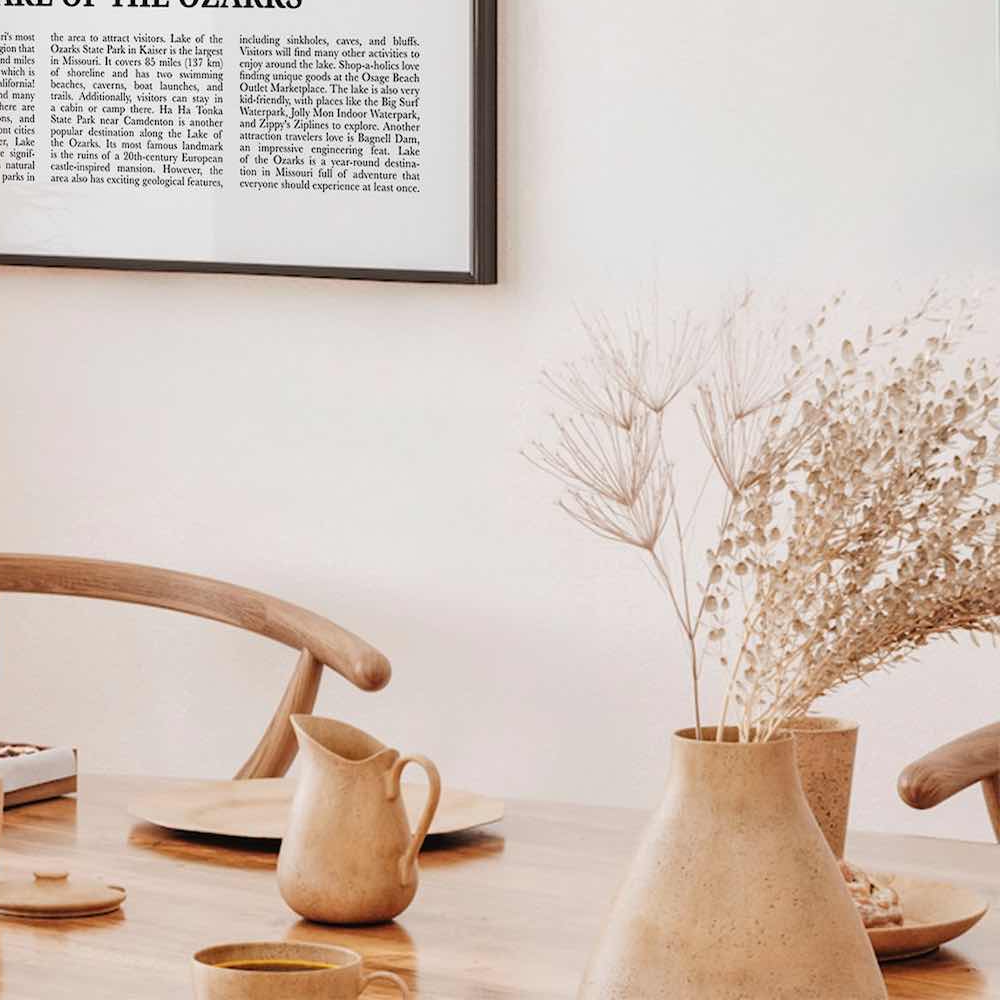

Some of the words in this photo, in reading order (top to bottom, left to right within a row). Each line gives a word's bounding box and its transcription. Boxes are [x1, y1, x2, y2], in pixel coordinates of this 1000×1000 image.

[14, 33, 34, 41] most
[50, 32, 63, 41] the
[89, 34, 98, 42] to
[102, 34, 129, 42] attract
[133, 34, 166, 42] visitors.
[170, 34, 190, 43] Lake
[194, 34, 205, 43] of
[209, 34, 223, 43] the
[239, 35, 280, 46] including
[286, 35, 329, 46] sinkholes,
[368, 36, 386, 45] and
[393, 36, 419, 46] bluffs.
[50, 44, 80, 53] Ozarks
[82, 44, 104, 54] State
[107, 45, 125, 54] Park
[128, 46, 136, 54] in
[139, 45, 166, 54] Kaiser
[169, 46, 176, 54] is
[178, 46, 192, 55] the
[194, 46, 223, 57] largest
[240, 47, 272, 56] Visitors
[275, 47, 291, 56] will
[294, 47, 311, 56] find
[314, 50, 339, 59] many
[341, 48, 365, 57] other
[368, 49, 407, 58] activities
[410, 50, 420, 58] to
[13, 55, 35, 64] miles
[239, 59, 263, 70] enjoy
[265, 59, 296, 68] around
[299, 59, 313, 68] the
[316, 60, 335, 69] lake.
[338, 60, 399, 72] Shop-a-holics
[401, 61, 419, 70] love
[50, 67, 60, 76] of
[67, 68, 104, 77] shoreline
[112, 68, 128, 78] and
[135, 69, 150, 78] has
[179, 70, 223, 81] swimming
[50, 79, 85, 90] beaches,
[92, 83, 126, 91] caverns,
[134, 81, 152, 90] boat
[159, 81, 199, 92] launches,
[206, 82, 223, 91] and
[19, 114, 35, 123] and
[239, 106, 288, 118] Waterpark,
[289, 107, 310, 119] Jolly
[313, 108, 334, 117] Mon
[336, 108, 367, 118] Indoor
[370, 109, 420, 121] Waterpark,
[50, 114, 71, 124] State
[76, 115, 95, 124] Park
[123, 116, 173, 126] Camdenton
[178, 118, 185, 126] is
[189, 117, 223, 127] another
[239, 118, 256, 128] and
[293, 120, 328, 131] Ziplines
[344, 121, 379, 132] explore.
[382, 121, 420, 131] Another
[13, 126, 35, 134] cities
[50, 126, 83, 138] popular
[88, 127, 134, 137] destination
[139, 128, 163, 140] along
[168, 129, 181, 138] the
[187, 129, 208, 138] Lake
[212, 130, 223, 139] of
[15, 137, 34, 146] Lake
[239, 131, 281, 140] attraction
[285, 131, 322, 141] travelers
[325, 132, 343, 142] love
[346, 134, 354, 142] is
[358, 133, 390, 145] Bagnell
[395, 134, 419, 145] Dam,
[258, 144, 303, 155] impressive
[310, 145, 363, 156] engineering
[370, 146, 390, 155] feat.
[398, 146, 420, 156] Lake
[50, 161, 110, 174] castle-inspired
[116, 164, 155, 173] mansion.
[162, 164, 202, 175] However,
[209, 165, 223, 175] the
[239, 167, 256, 176] tion
[262, 168, 270, 176] in
[275, 167, 312, 177] Missouri
[318, 168, 332, 178] full
[337, 169, 347, 178] of
[352, 169, 397, 179] adventure
[402, 171, 420, 180] that
[71, 173, 87, 183] also
[90, 174, 104, 183] has
[106, 175, 140, 186] exciting
[142, 175, 184, 188] geological
[187, 177, 223, 188] features,
[239, 181, 278, 190] everyone
[280, 179, 310, 189] should
[312, 181, 359, 193] experience
[362, 183, 370, 191] at
[373, 182, 393, 191] least
